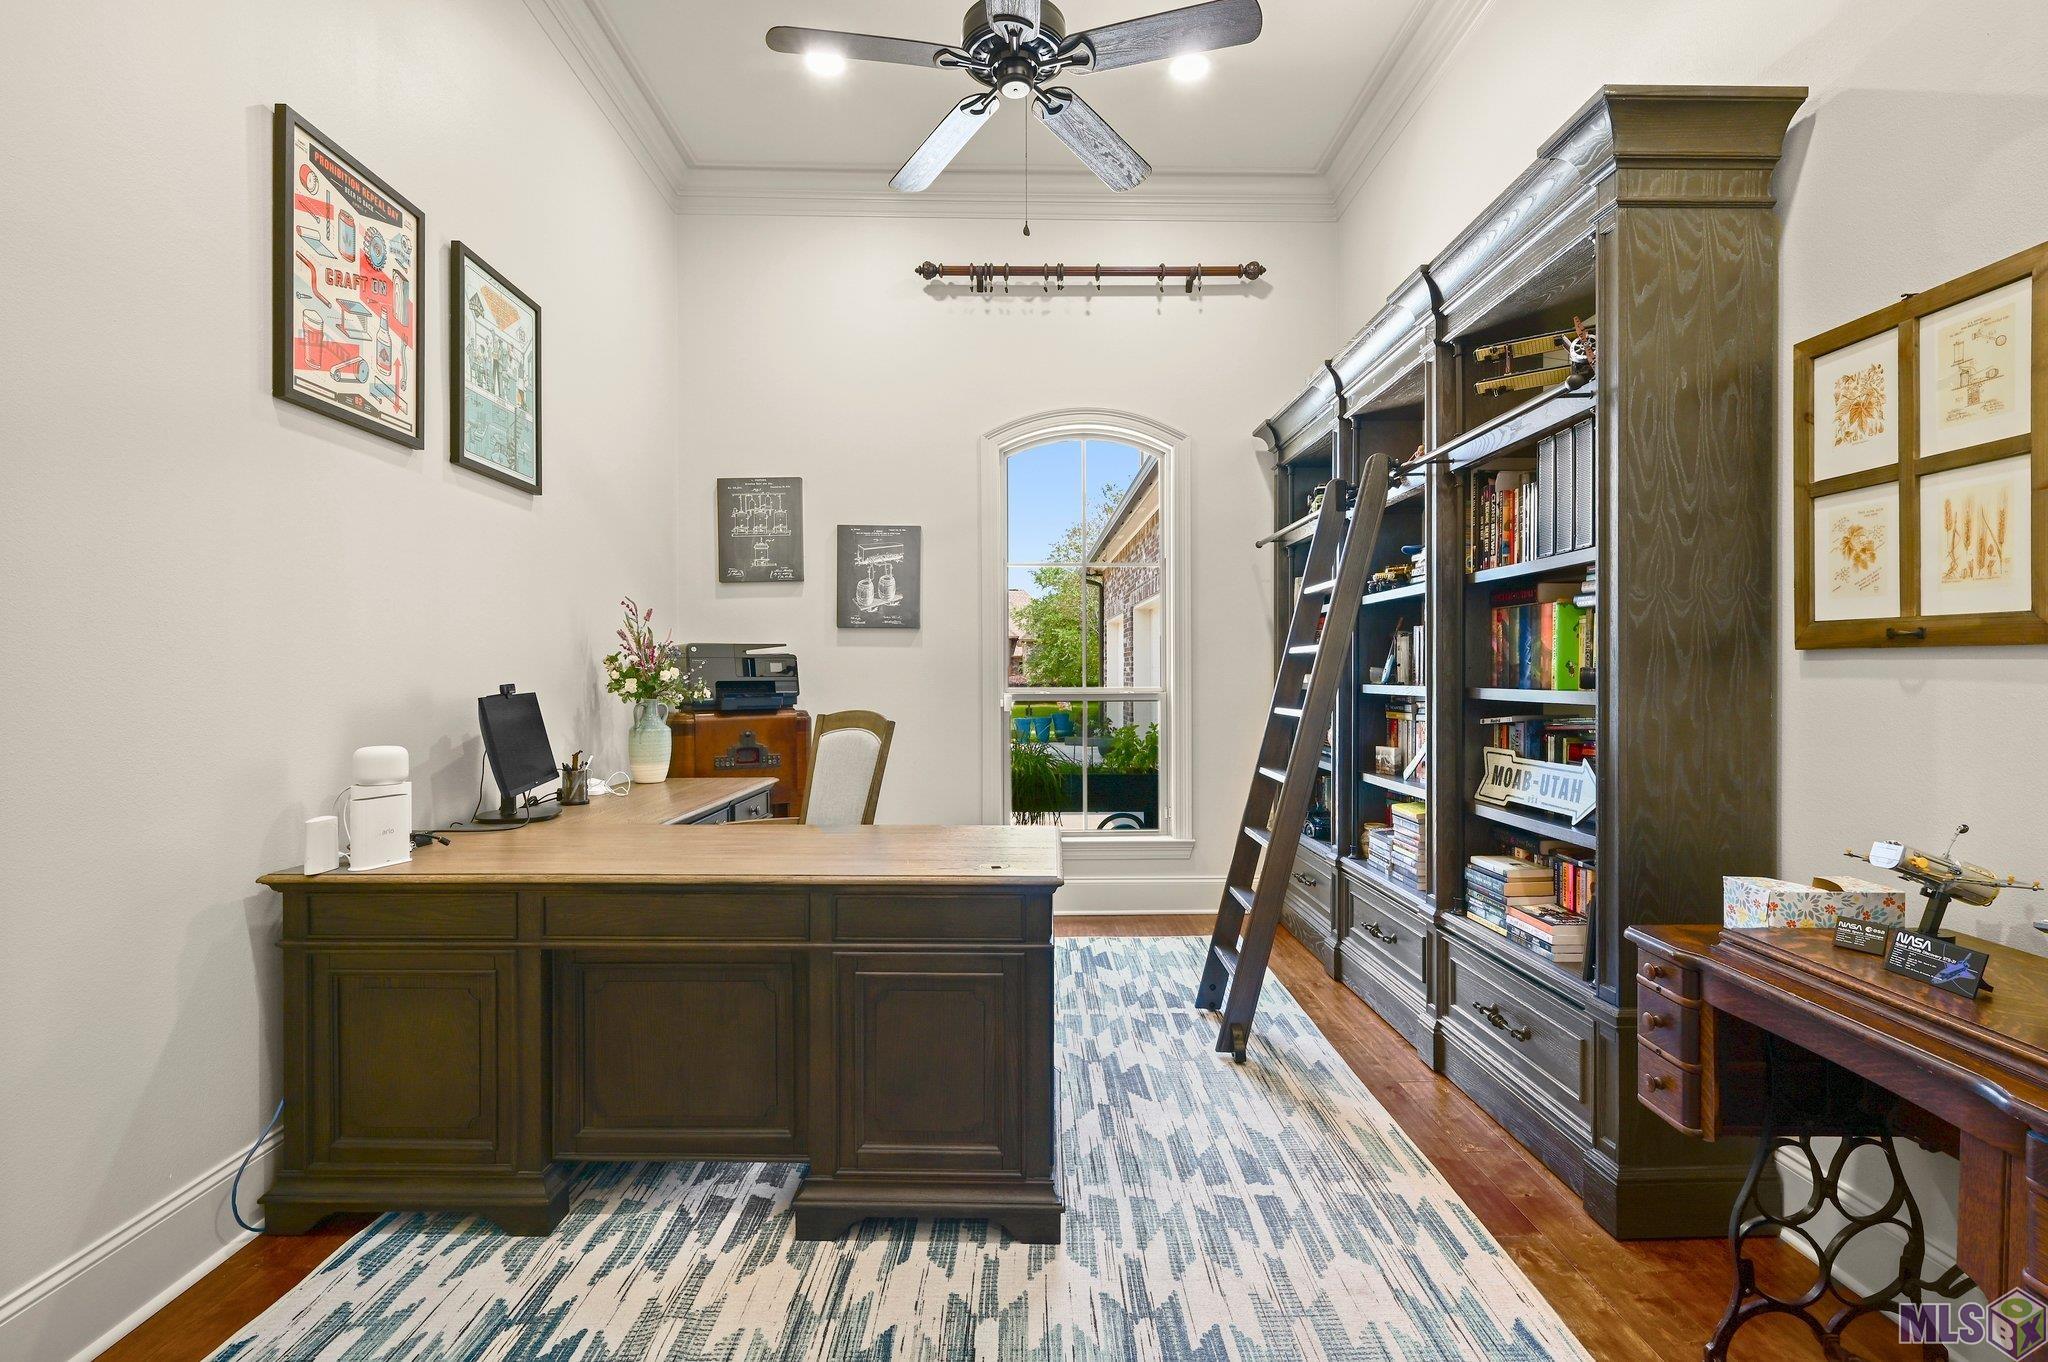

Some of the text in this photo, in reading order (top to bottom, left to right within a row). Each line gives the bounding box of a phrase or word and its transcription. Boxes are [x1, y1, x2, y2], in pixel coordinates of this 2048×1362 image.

[314, 150, 360, 193] PROHIBITION
[362, 187, 386, 212] REPEAL
[386, 206, 399, 221] DAY
[344, 186, 357, 199] BEER
[362, 199, 374, 212] BACK
[325, 267, 388, 297] CRAFT ON
[1838, 920, 1863, 931] NASA
[1895, 941, 1908, 949] Space
[1908, 945, 1921, 953] Shuttle
[1922, 950, 1942, 961] Discovery
[1896, 932, 1931, 952] NASA
